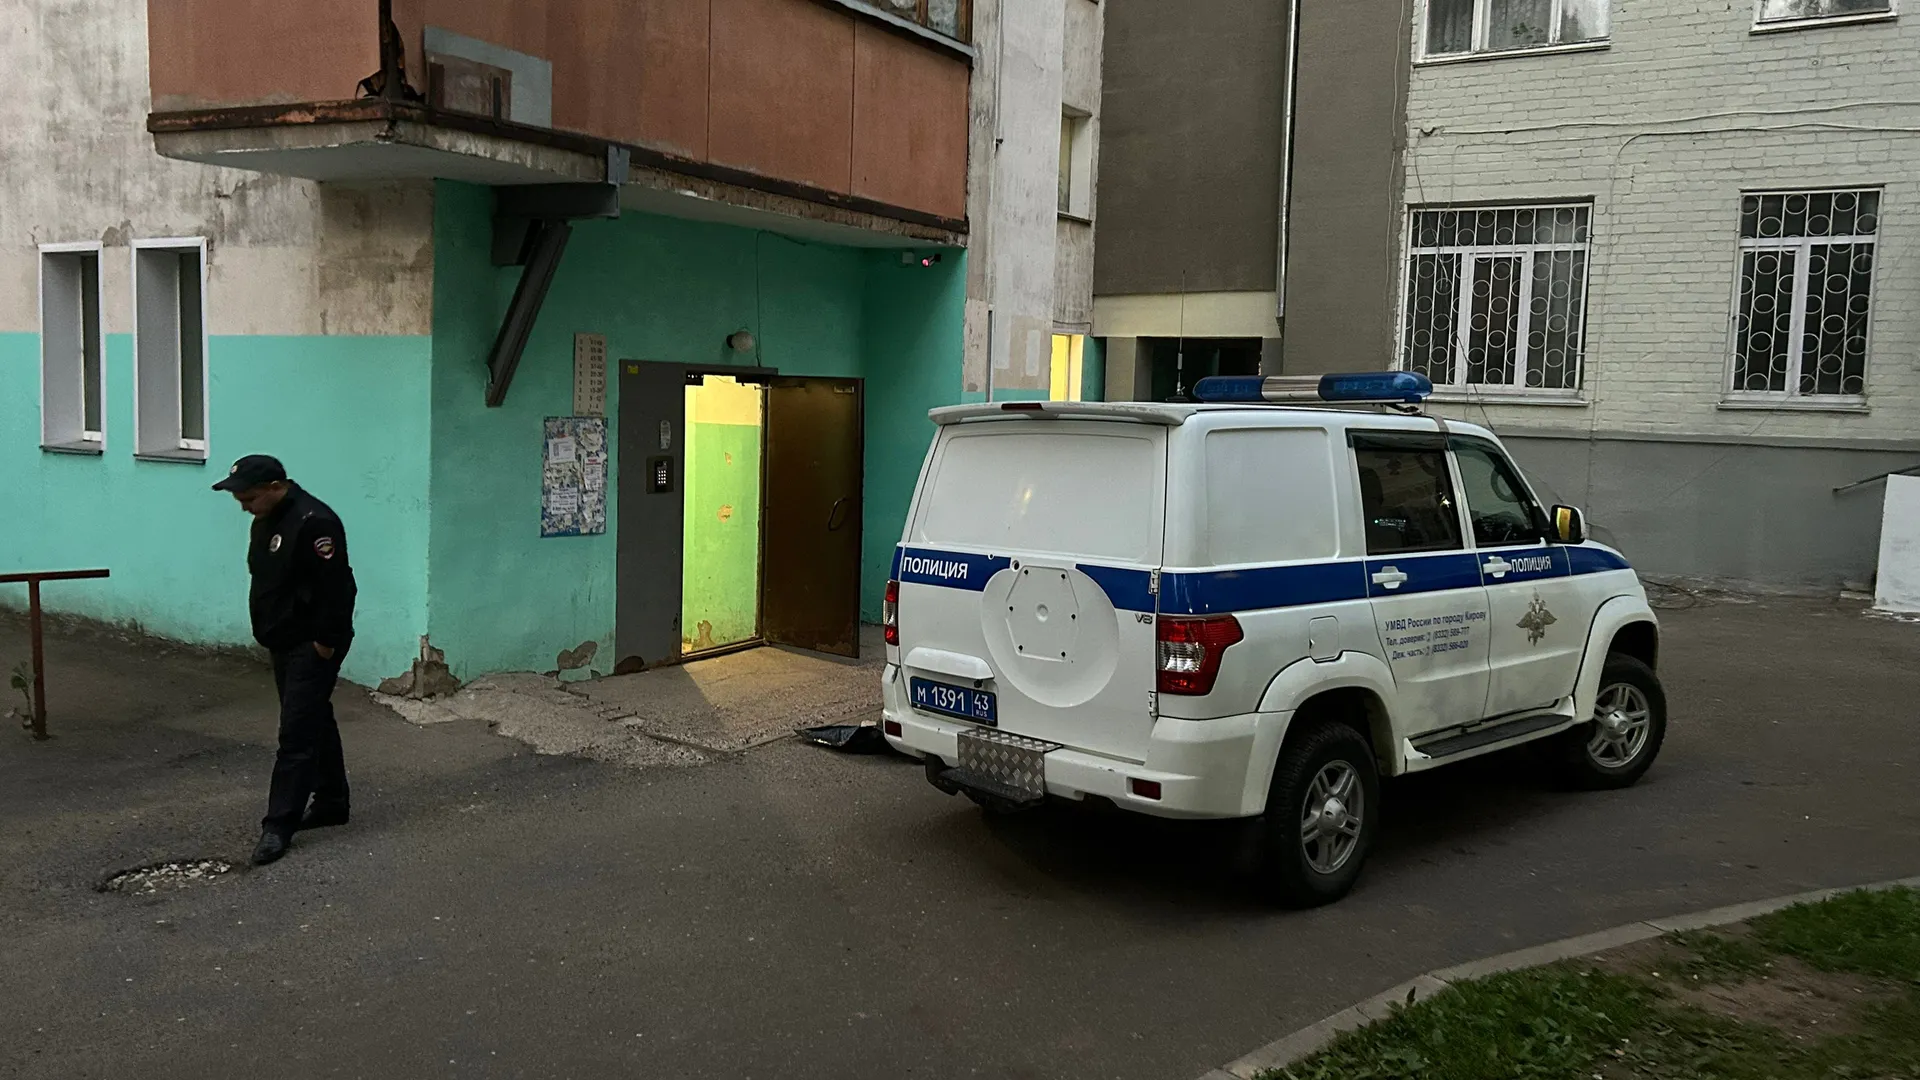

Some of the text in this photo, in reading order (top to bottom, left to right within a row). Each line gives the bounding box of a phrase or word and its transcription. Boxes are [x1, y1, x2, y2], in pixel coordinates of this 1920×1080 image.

[903, 556, 968, 579] ПОЛИЦИЯ
[1511, 556, 1551, 573] ПОЛИЦИЯ
[1385, 611, 1487, 631] УМВД России по городу Кирову
[1386, 637, 1399, 646] Тел.
[931, 685, 964, 711] 1391
[973, 693, 989, 710] 43
[975, 709, 987, 717] RUS
